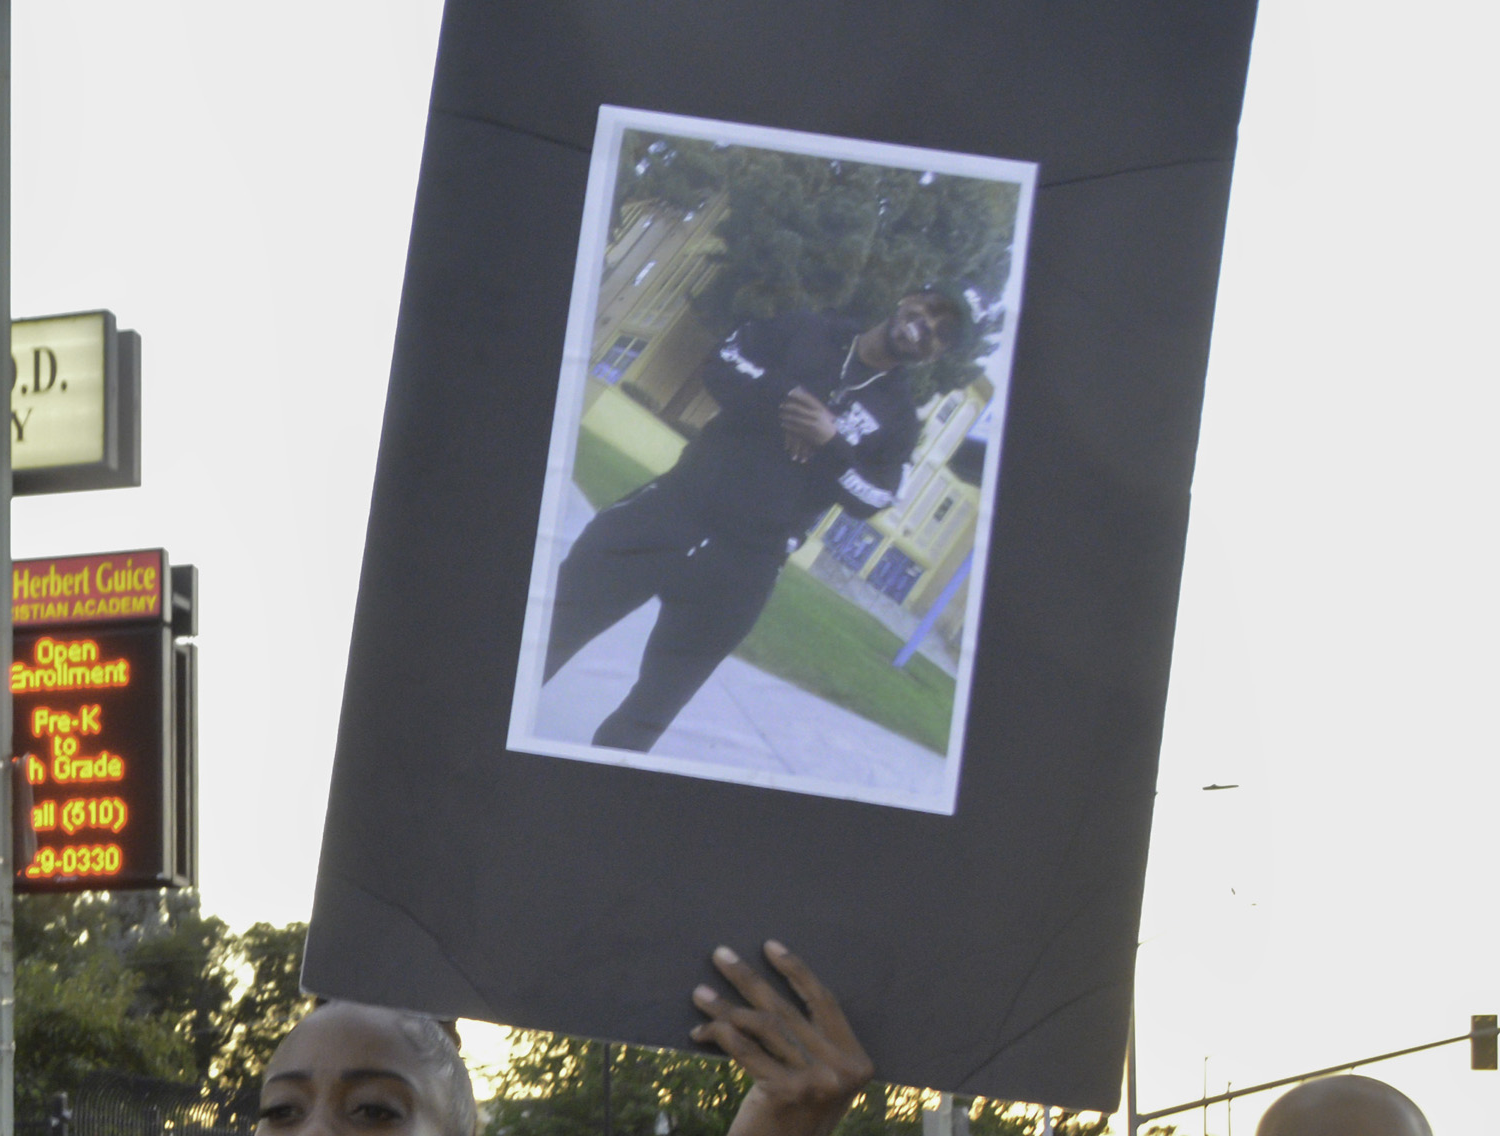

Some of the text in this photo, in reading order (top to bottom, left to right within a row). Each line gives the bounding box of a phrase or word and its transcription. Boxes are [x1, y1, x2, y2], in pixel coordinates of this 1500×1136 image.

[11, 346, 68, 397] .D.
[12, 558, 156, 600] Herbert Guice
[11, 594, 158, 623] ISTIAN ACADEMY
[35, 638, 98, 669] Open
[10, 659, 128, 691] Enrollment
[33, 706, 101, 736] Pre-K
[53, 734, 78, 757] to
[53, 751, 124, 781] Grade
[31, 797, 127, 833] all (510)
